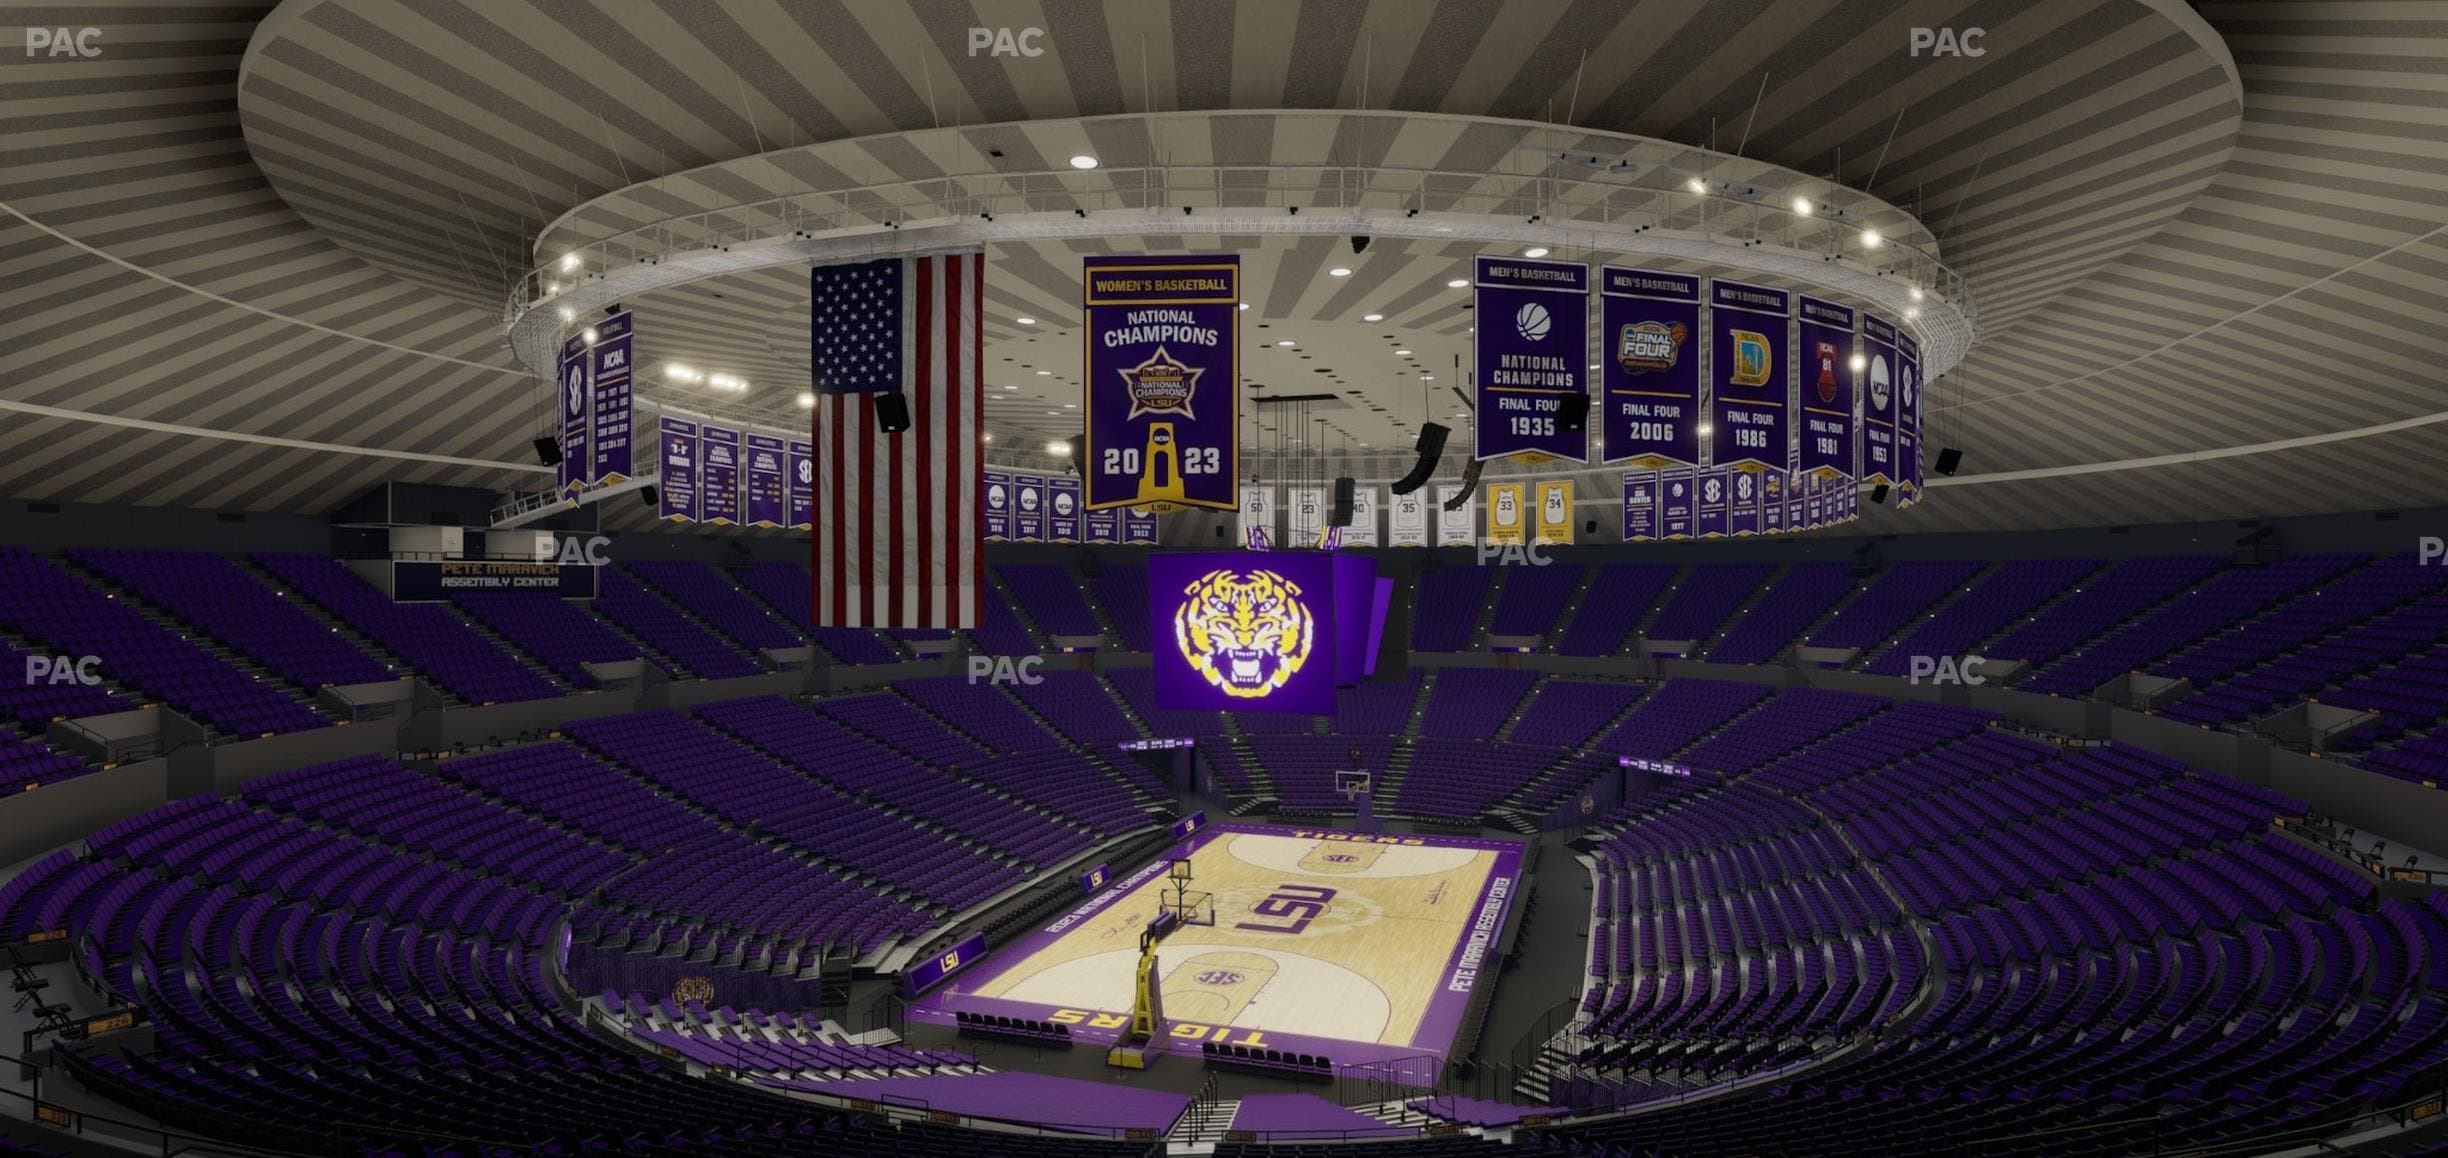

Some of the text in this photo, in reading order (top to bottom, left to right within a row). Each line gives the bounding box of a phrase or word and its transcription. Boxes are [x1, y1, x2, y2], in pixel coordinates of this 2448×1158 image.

[1489, 267, 1575, 282] MEN'S BASKETBALL
[1097, 279, 1227, 292] WOMEN'S BASKETBALL
[1614, 276, 1690, 293] MEN'S BASKETBALL
[1720, 288, 1781, 307] MEN'S BASKETBALL
[1128, 310, 1195, 325] NATIONAL
[1104, 326, 1218, 347] CHAMPIONS
[1636, 332, 1671, 345] FINAL
[1624, 342, 1671, 357] FOUR
[1502, 355, 1565, 370] NATIONAL
[1822, 358, 1832, 371] 81
[1141, 381, 1182, 389] NATIONAL
[1493, 371, 1573, 386] CHAMPIONS
[1136, 388, 1187, 397] CHAMPIONS
[1499, 398, 1560, 412] FINAL FOU
[1622, 403, 1681, 418] FINAL FOUR
[1727, 411, 1775, 426] FINAL FOUR
[1510, 417, 1555, 436] 1935
[1630, 422, 1674, 441] 2006
[1810, 419, 1844, 434] FINAL FOUR
[1735, 429, 1767, 448] 1986
[1817, 437, 1838, 456] 1981
[1104, 447, 1220, 475] 20 23
[1872, 446, 1887, 464] 1953
[1250, 501, 1263, 513] 50
[1402, 503, 1415, 513] 35
[1500, 500, 1512, 511] 33
[1549, 498, 1561, 509] 34
[441, 564, 560, 575] PETE MARAVICH
[441, 577, 559, 587] ASSEMBLY CENTER
[1185, 819, 1195, 833] LSU
[1293, 830, 1424, 846] TIGERS
[1327, 853, 1357, 863] SEC
[1090, 870, 1103, 888] LSU
[1234, 885, 1338, 935] LSU
[1044, 913, 1083, 933] 2023
[1448, 876, 1511, 993] PETE MARAVICH ASSEMBLY CENTER
[940, 950, 960, 974] LSU
[1198, 970, 1241, 986] SEC
[1048, 1008, 1270, 1048] TIGRS
